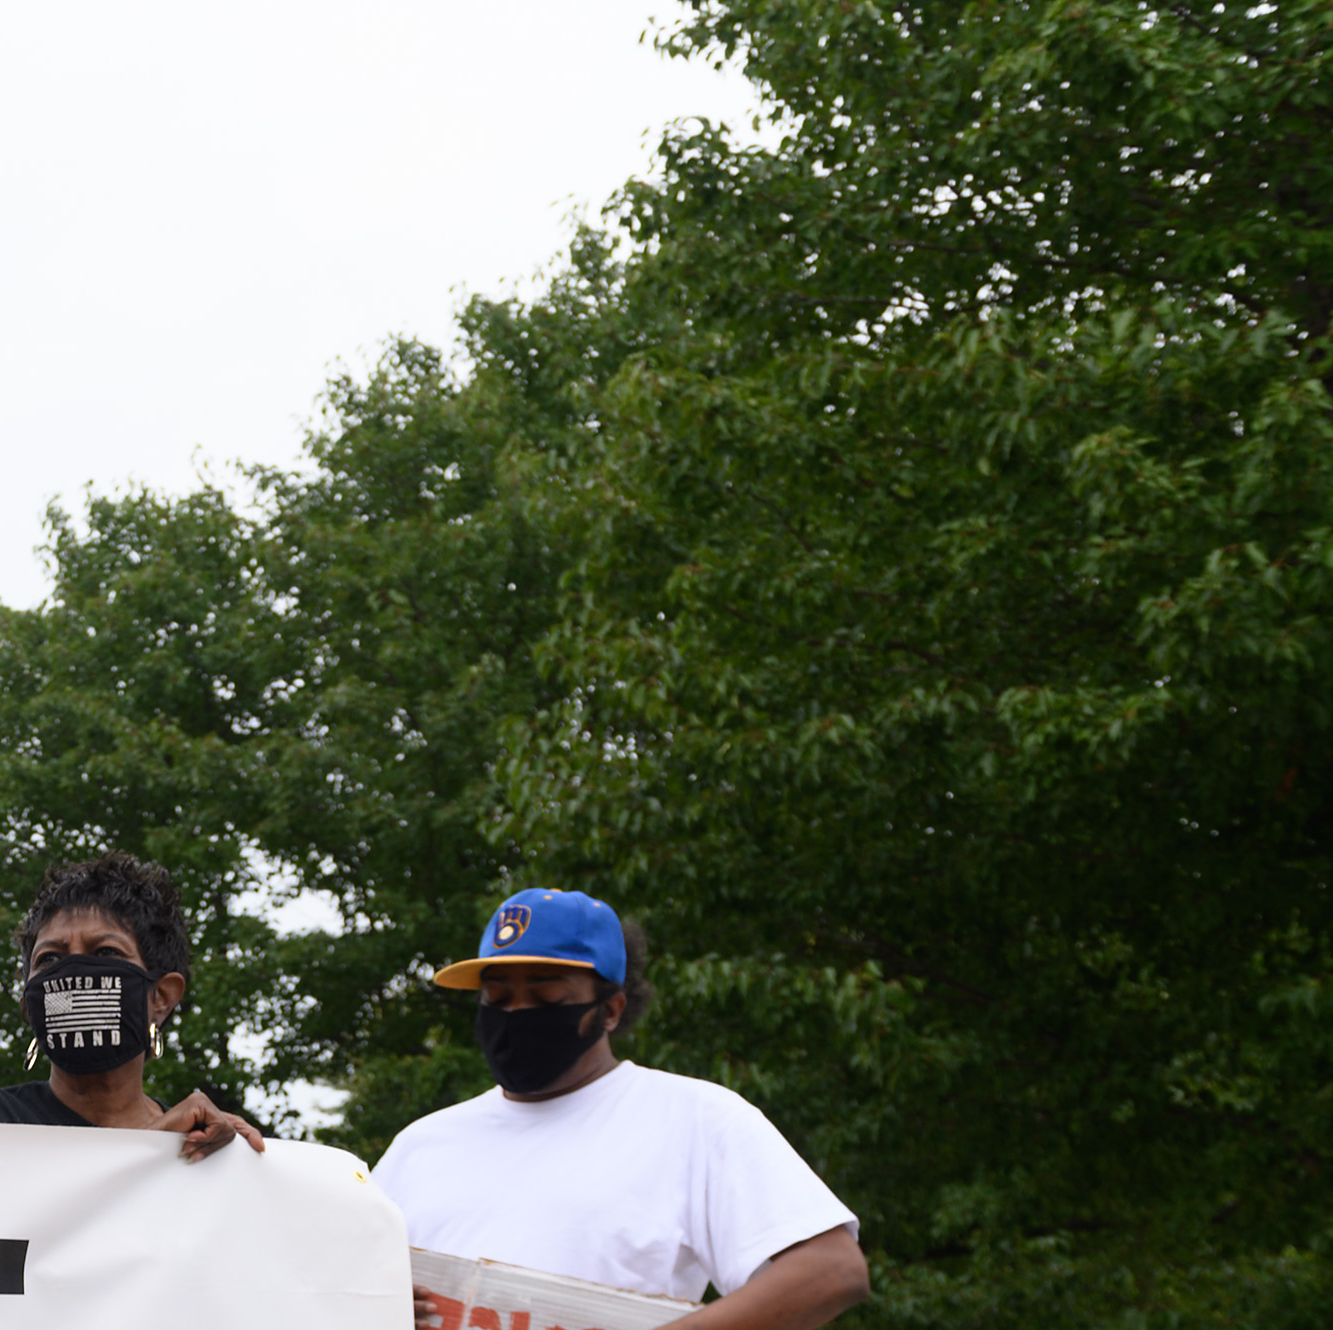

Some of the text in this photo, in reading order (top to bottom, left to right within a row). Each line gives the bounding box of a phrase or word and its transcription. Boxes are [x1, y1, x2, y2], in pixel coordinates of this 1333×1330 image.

[43, 975, 123, 994] UNITED WE
[46, 1029, 121, 1050] STAND
